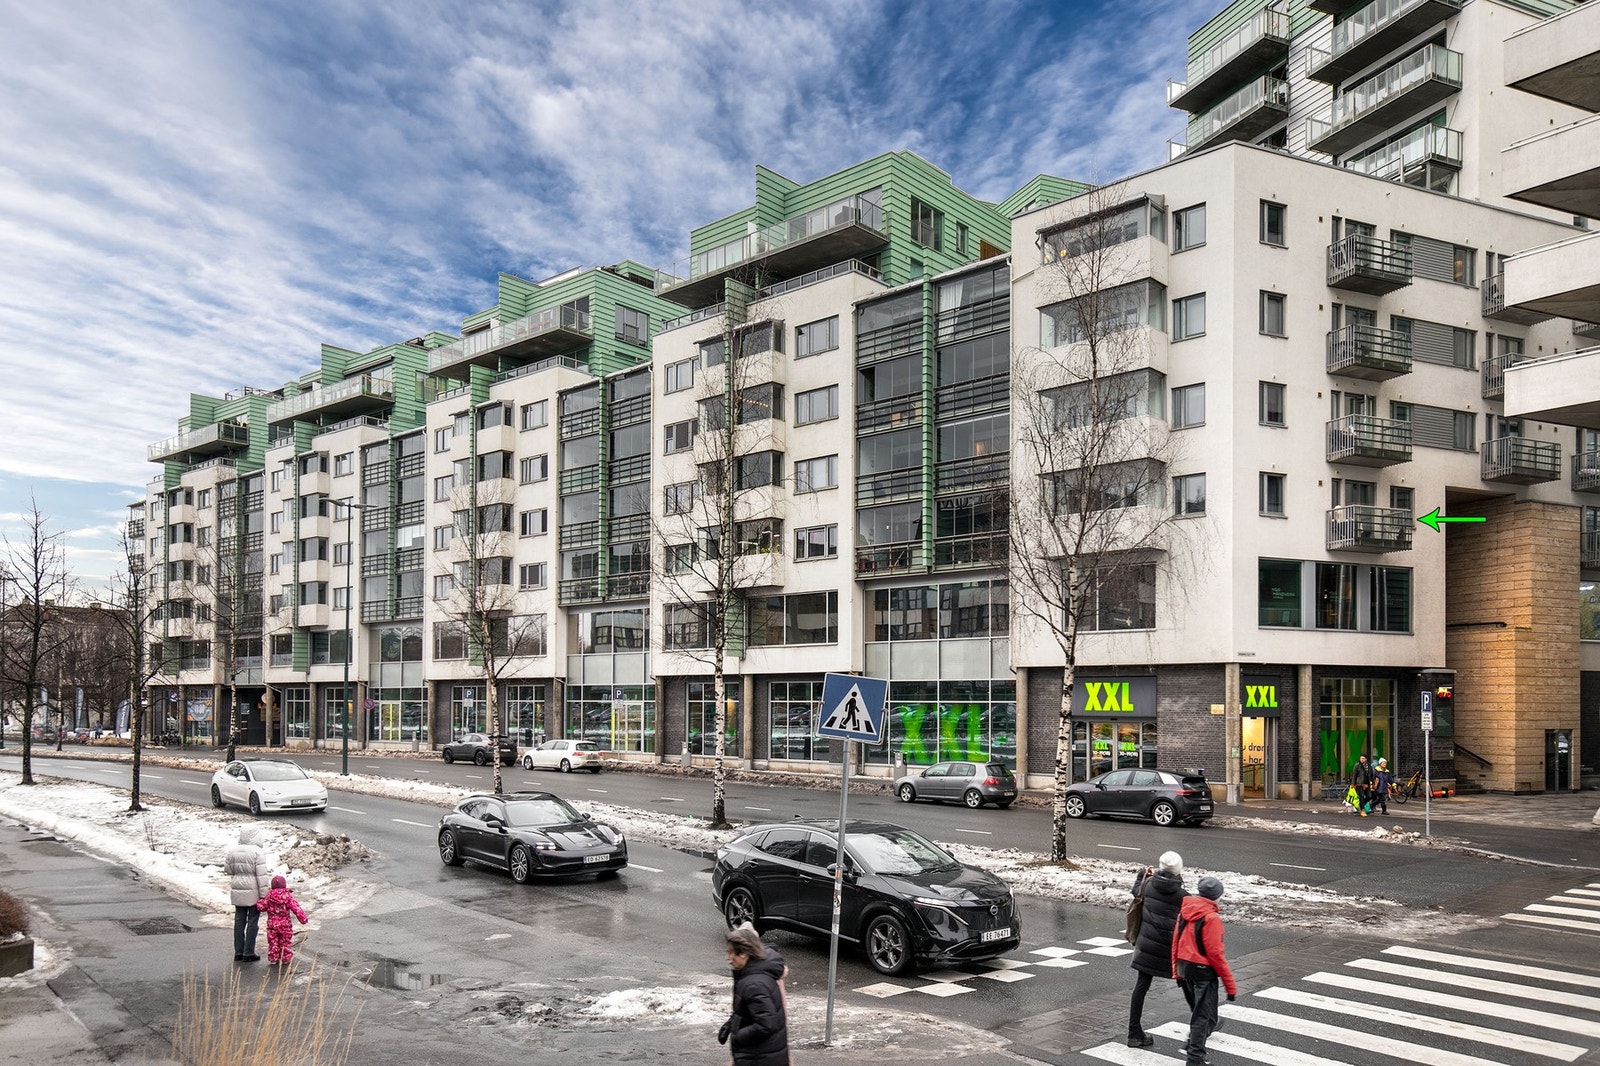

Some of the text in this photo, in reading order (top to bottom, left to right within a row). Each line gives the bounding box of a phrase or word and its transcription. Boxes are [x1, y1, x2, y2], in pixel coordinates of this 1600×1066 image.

[616, 690, 622, 698] P
[1084, 682, 1134, 712] XXL
[1245, 686, 1278, 708] XXL
[1424, 694, 1430, 710] P
[1094, 741, 1109, 750] XXL
[1248, 755, 1262, 763] har
